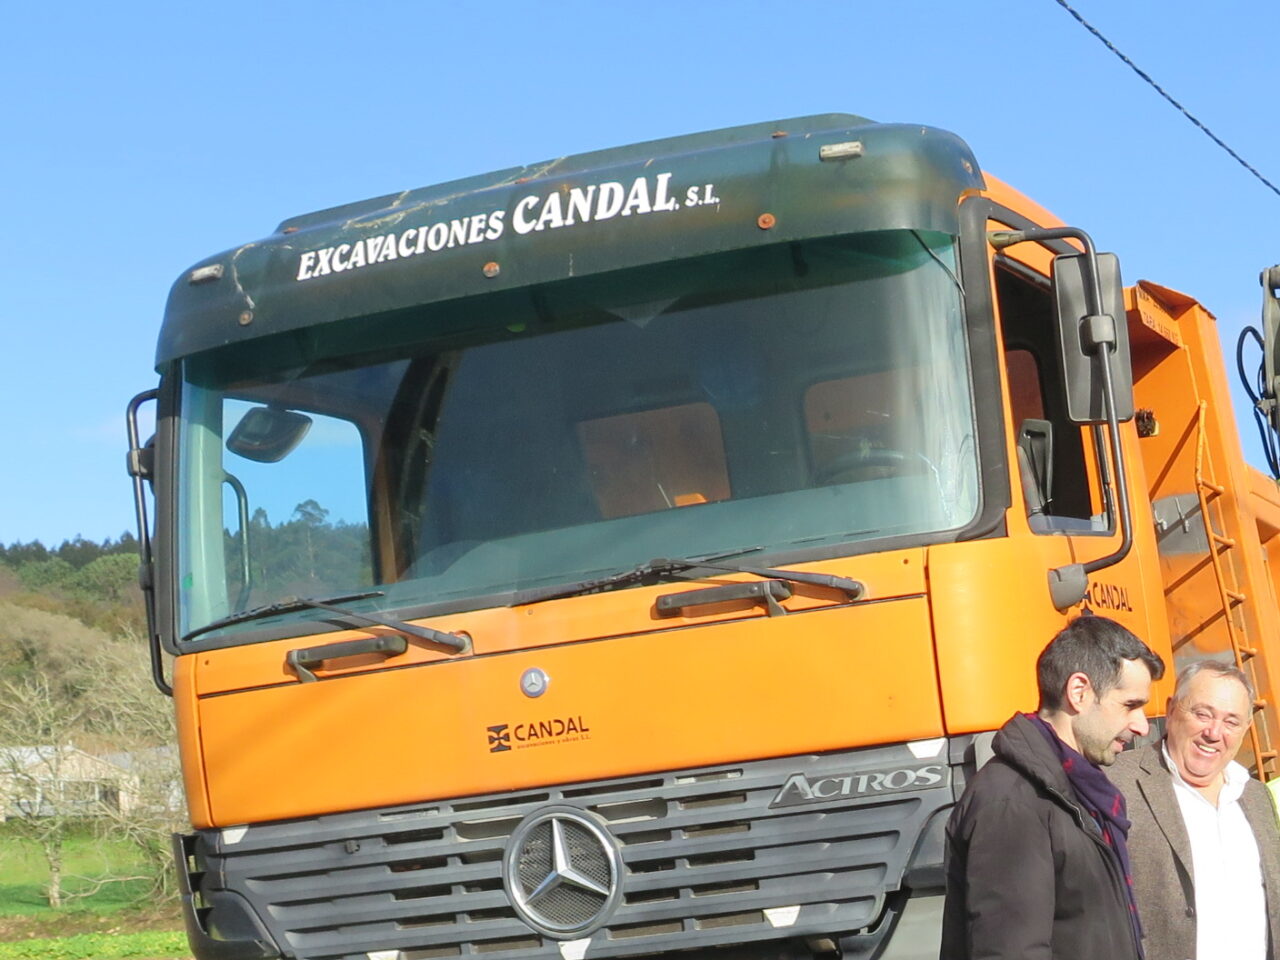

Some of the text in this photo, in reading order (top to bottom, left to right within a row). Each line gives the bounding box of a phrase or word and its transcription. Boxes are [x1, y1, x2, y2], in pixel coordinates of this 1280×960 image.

[296, 211, 506, 281] EXCAVACIONES
[1092, 582, 1133, 612] CANDAL
[513, 715, 590, 741] CANDAL
